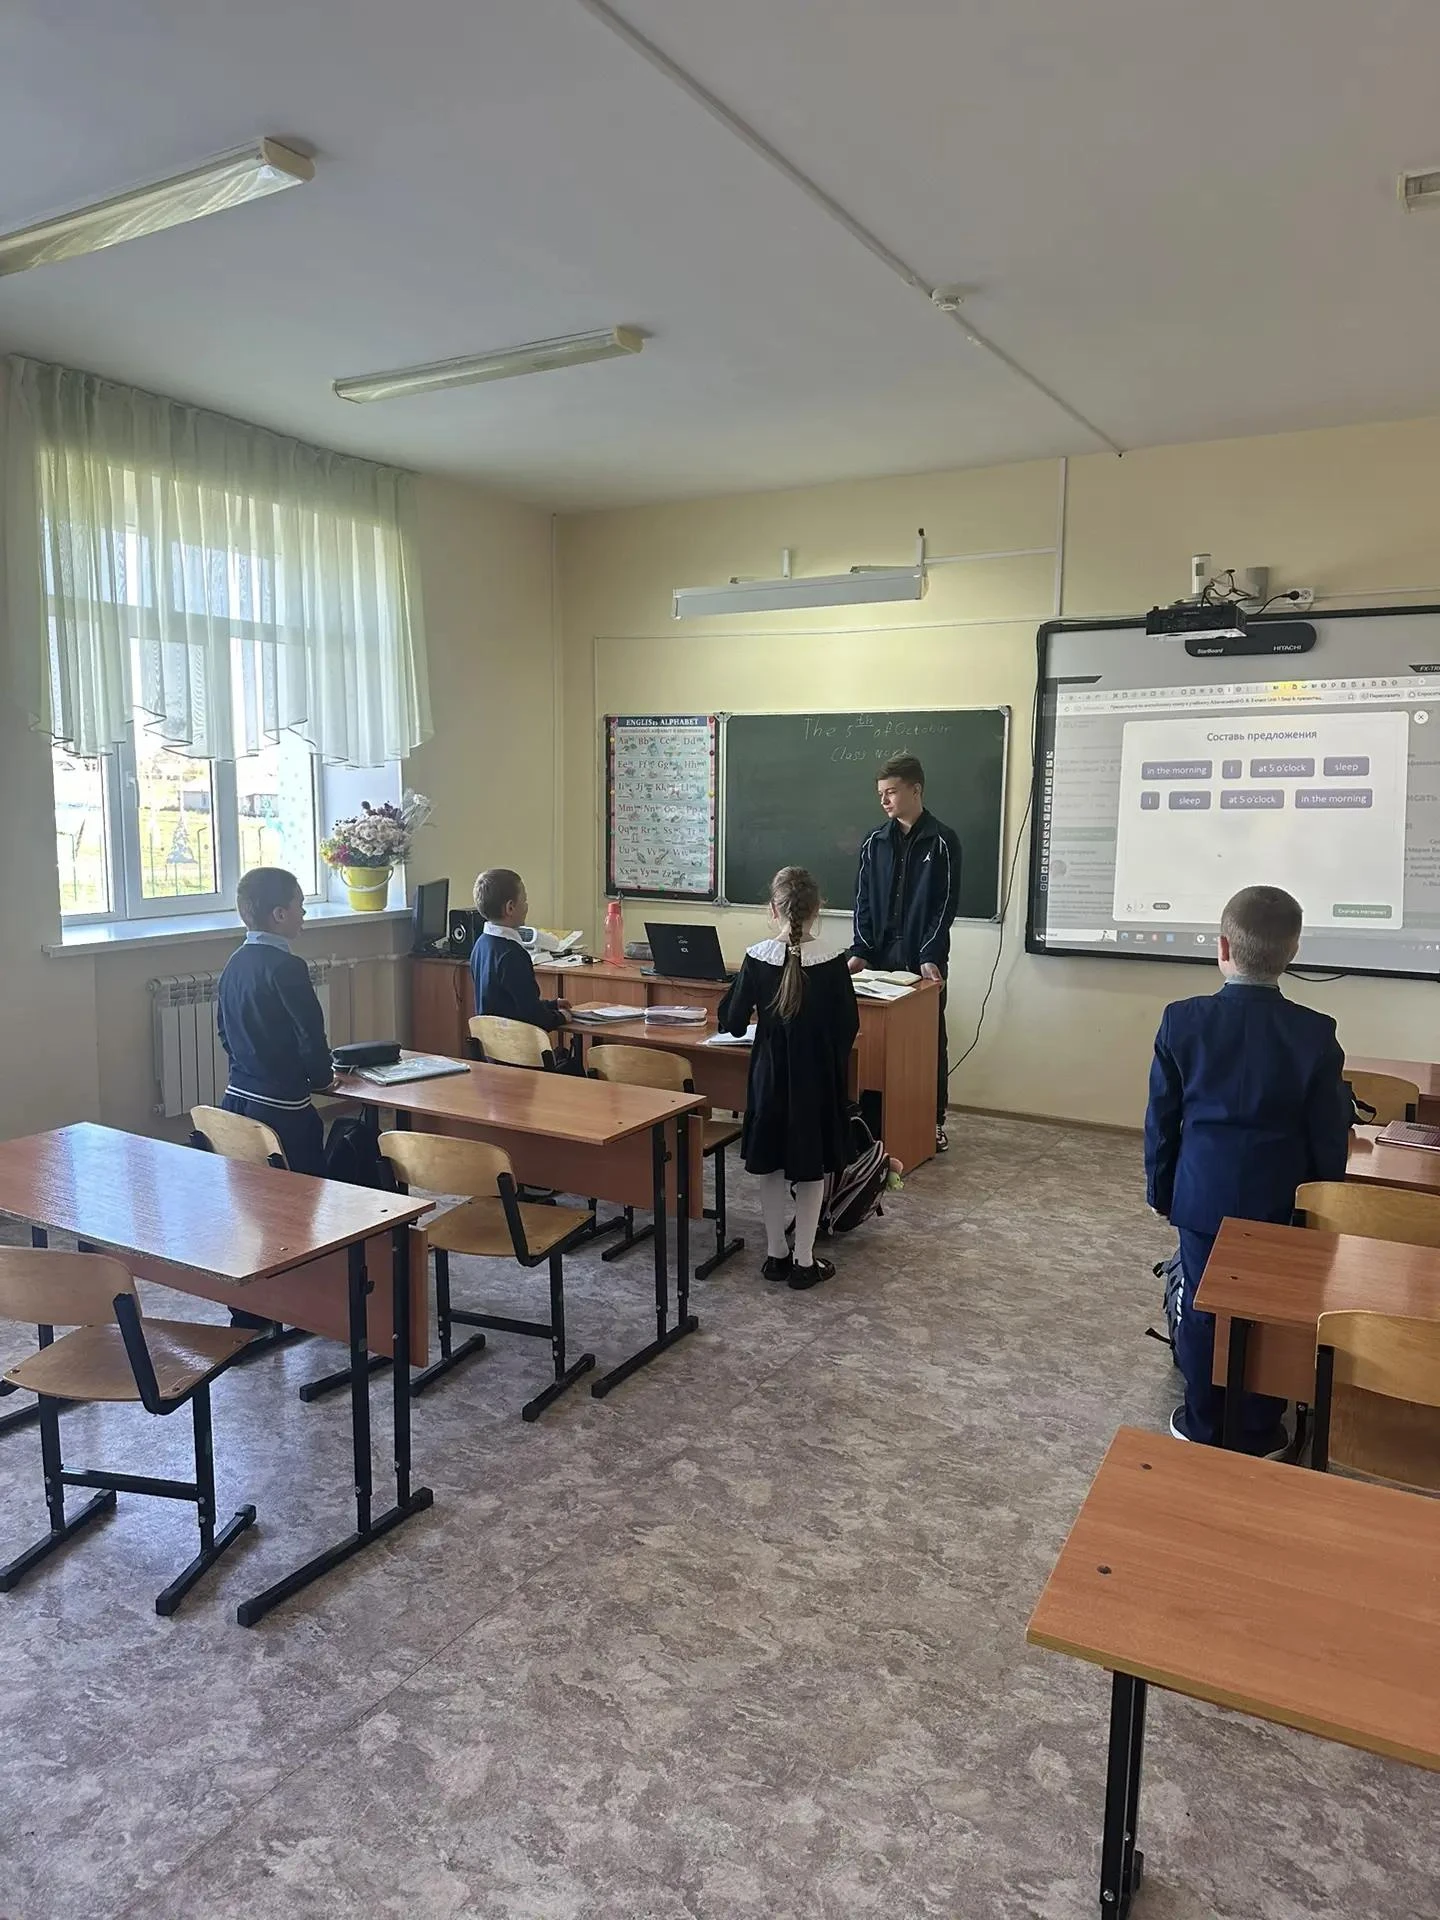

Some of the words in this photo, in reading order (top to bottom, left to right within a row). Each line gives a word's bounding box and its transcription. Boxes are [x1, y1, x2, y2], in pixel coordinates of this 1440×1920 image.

[804, 717, 836, 740] The
[873, 721, 893, 737] of
[1207, 733, 1245, 741] Составь
[1247, 731, 1317, 742] предложения
[1172, 767, 1207, 775] morning
[1258, 765, 1267, 773] at
[1269, 764, 1275, 772] 5
[1276, 762, 1306, 772] o'clock
[1334, 761, 1359, 772] sleep
[1178, 796, 1201, 806] sleep
[1228, 795, 1238, 803] at
[1239, 795, 1246, 803] 5
[1246, 794, 1276, 803] o'clock
[1311, 794, 1326, 802] the
[1328, 793, 1367, 803] morning
